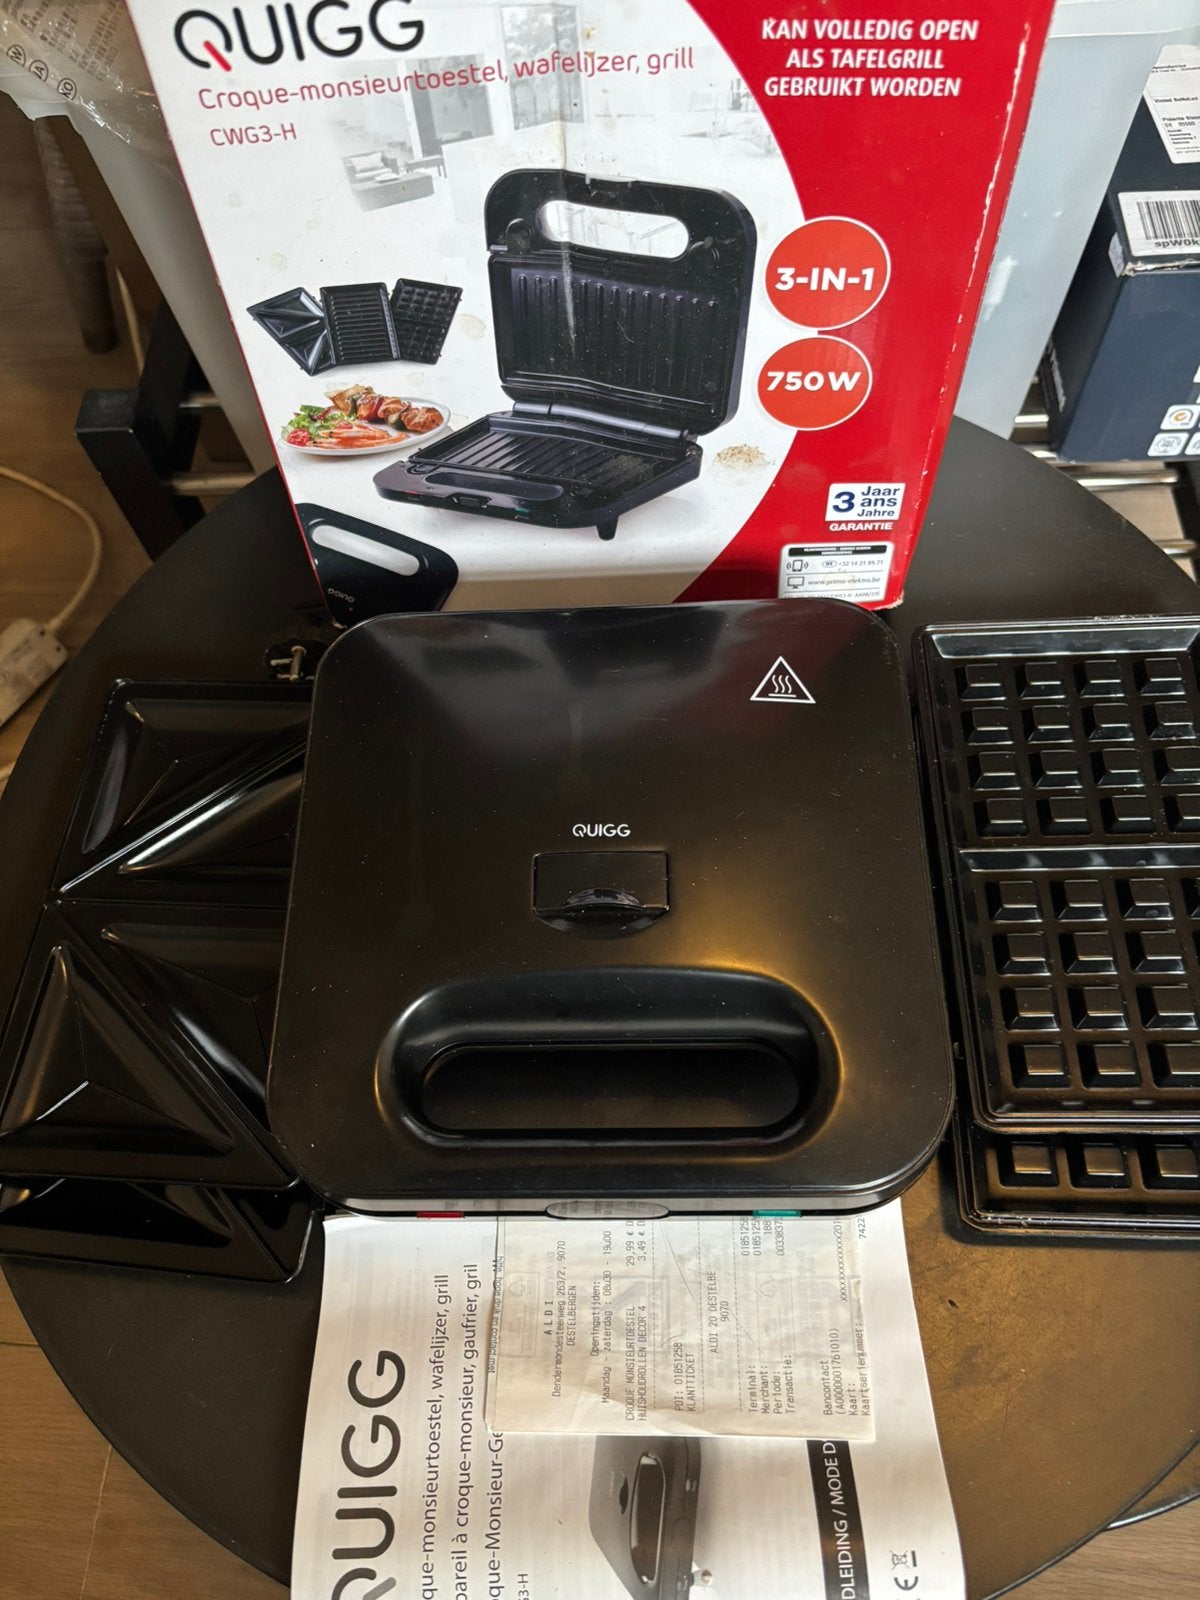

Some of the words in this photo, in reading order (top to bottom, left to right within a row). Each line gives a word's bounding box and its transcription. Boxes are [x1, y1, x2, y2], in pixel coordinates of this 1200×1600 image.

[173, 0, 425, 72] QUIGG
[762, 18, 807, 40] KAN
[814, 19, 913, 41] VOLLEDIG
[919, 19, 979, 41] OPEN
[785, 48, 824, 69] ALS
[831, 48, 945, 70] TAFELGRILL
[198, 62, 508, 111] Croque-monsieurtoestel,
[514, 50, 640, 79] wafelijzer,
[647, 47, 695, 75] grill
[764, 77, 865, 97] GEBRUIKT
[870, 77, 962, 97] WORDEN
[209, 123, 297, 147] CWG3-H
[775, 267, 875, 291] 3-IN-1
[832, 491, 856, 513] 3
[860, 497, 898, 508] ans
[861, 486, 901, 497] Jaar
[829, 522, 893, 532] GARANTIE
[857, 509, 896, 518] Jahre
[572, 823, 631, 837] QUIGG
[556, 1240, 566, 1261] 9070
[602, 1230, 612, 1255] 19u00
[625, 1240, 636, 1266] 29,99
[637, 1240, 647, 1261] 3,49
[434, 1274, 452, 1305] grill
[463, 1264, 482, 1291] gril
[602, 1270, 612, 1296] 08u30
[707, 1270, 718, 1311] DESTELBE
[566, 1285, 577, 1346] DESTELBERGEN
[590, 1281, 601, 1357] Openingstijden:
[708, 1316, 718, 1328] 20
[719, 1300, 730, 1322] 9070
[462, 1292, 480, 1360] gaufrier,
[638, 1313, 647, 1343] DECOR
[430, 1307, 450, 1391] wafelijzer,
[625, 1306, 636, 1384] MONSIEURTOESTEL
[709, 1333, 719, 1353] ALDI
[673, 1342, 683, 1385] 01851258
[601, 1366, 612, 1404] Maandag
[637, 1346, 647, 1421] HUISHOUDROLLEN
[685, 1353, 696, 1412] KLANTTICKET
[760, 1365, 770, 1414] Merchant:
[820, 1360, 833, 1416] Bancontact
[625, 1388, 636, 1421] CROQUE
[848, 1383, 858, 1416] Kaart:
[456, 1364, 475, 1527] croque-monsieur,
[825, 1457, 845, 1505] MODE
[451, 1533, 468, 1544] à
[517, 1573, 530, 1600] 3-H
